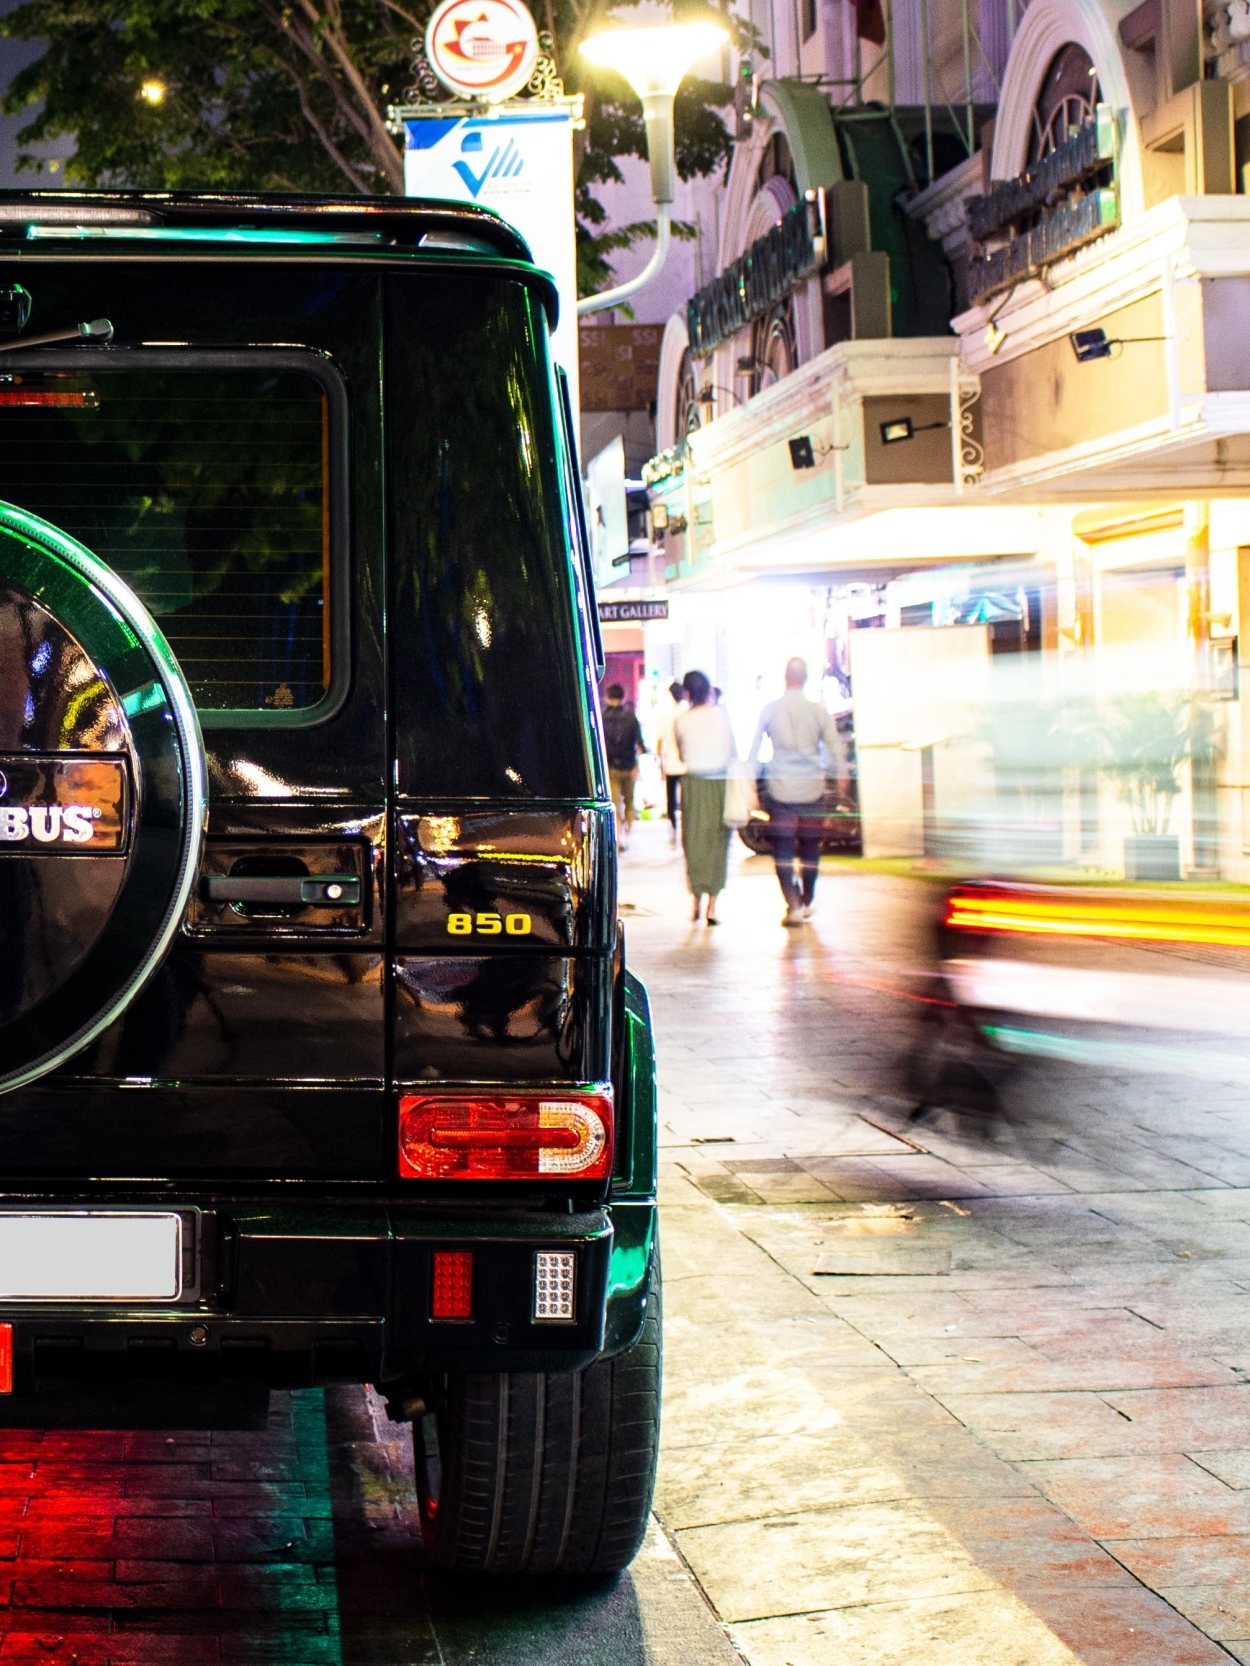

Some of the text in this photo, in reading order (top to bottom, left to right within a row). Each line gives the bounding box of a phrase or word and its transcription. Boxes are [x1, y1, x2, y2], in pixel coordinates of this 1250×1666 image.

[598, 604, 667, 619] ART GALLERY
[447, 912, 532, 935] 850
